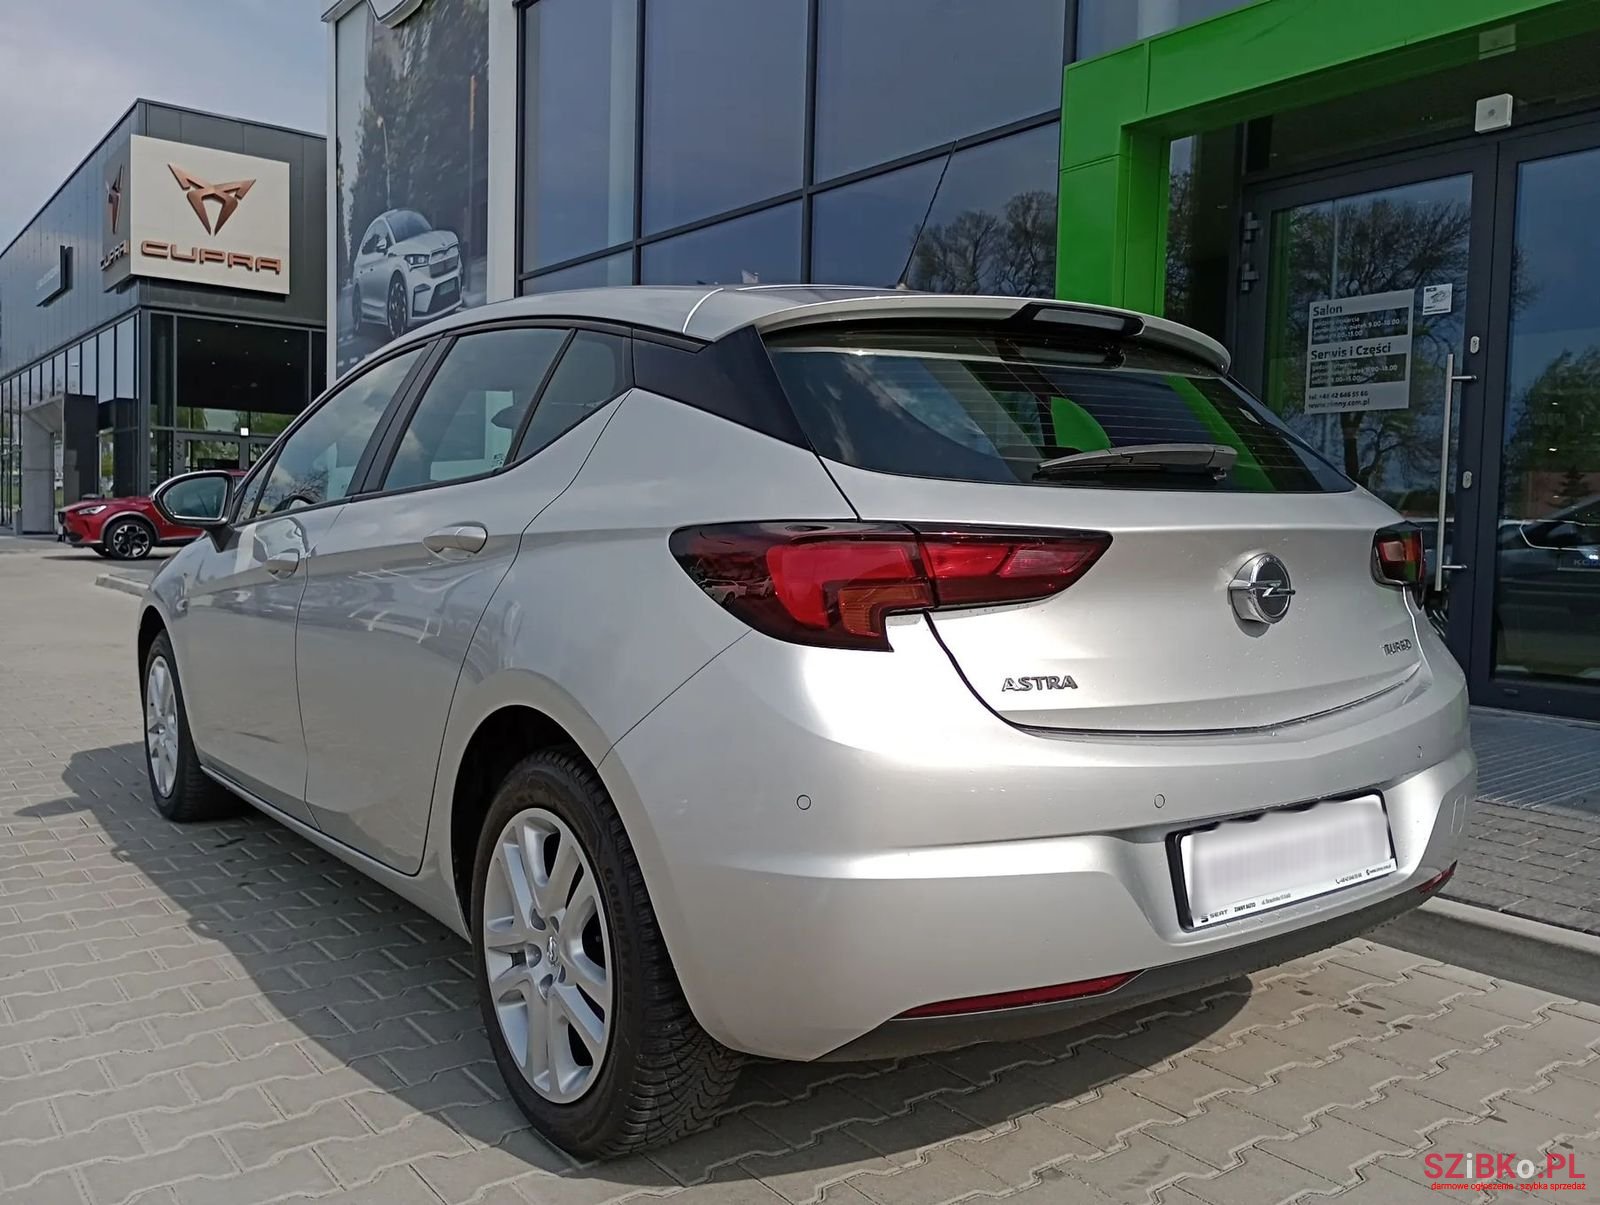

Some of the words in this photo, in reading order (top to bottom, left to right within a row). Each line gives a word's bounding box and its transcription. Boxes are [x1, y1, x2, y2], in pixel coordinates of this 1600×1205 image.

[141, 240, 281, 275] CUPRA
[1313, 304, 1343, 317] Salon
[1349, 346, 1353, 356] i
[1356, 342, 1392, 357] Części
[1001, 675, 1078, 692] ASTRA
[1210, 909, 1228, 918] SEAT
